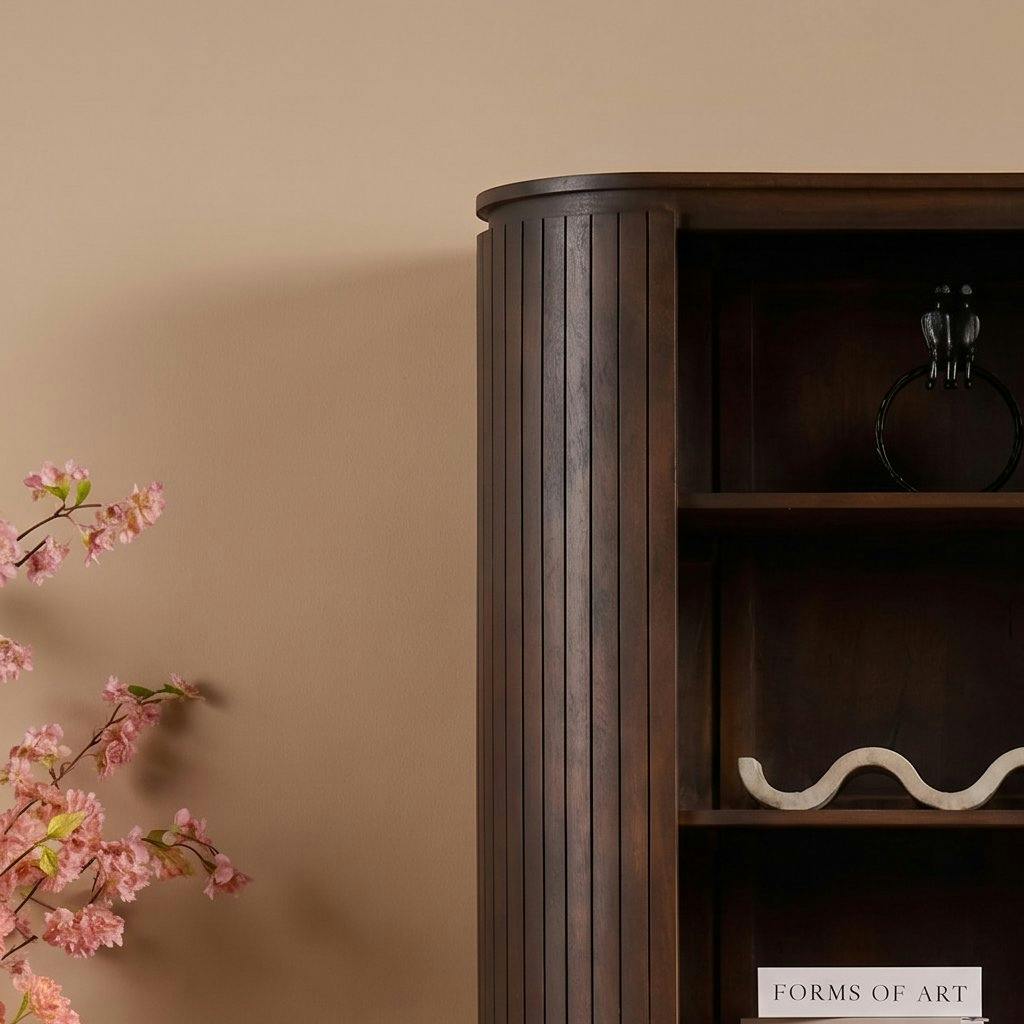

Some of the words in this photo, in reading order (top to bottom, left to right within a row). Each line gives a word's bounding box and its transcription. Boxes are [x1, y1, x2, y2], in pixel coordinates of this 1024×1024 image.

[773, 983, 861, 1002] FORMS
[871, 984, 905, 1003] OF
[917, 985, 968, 1003] ART
